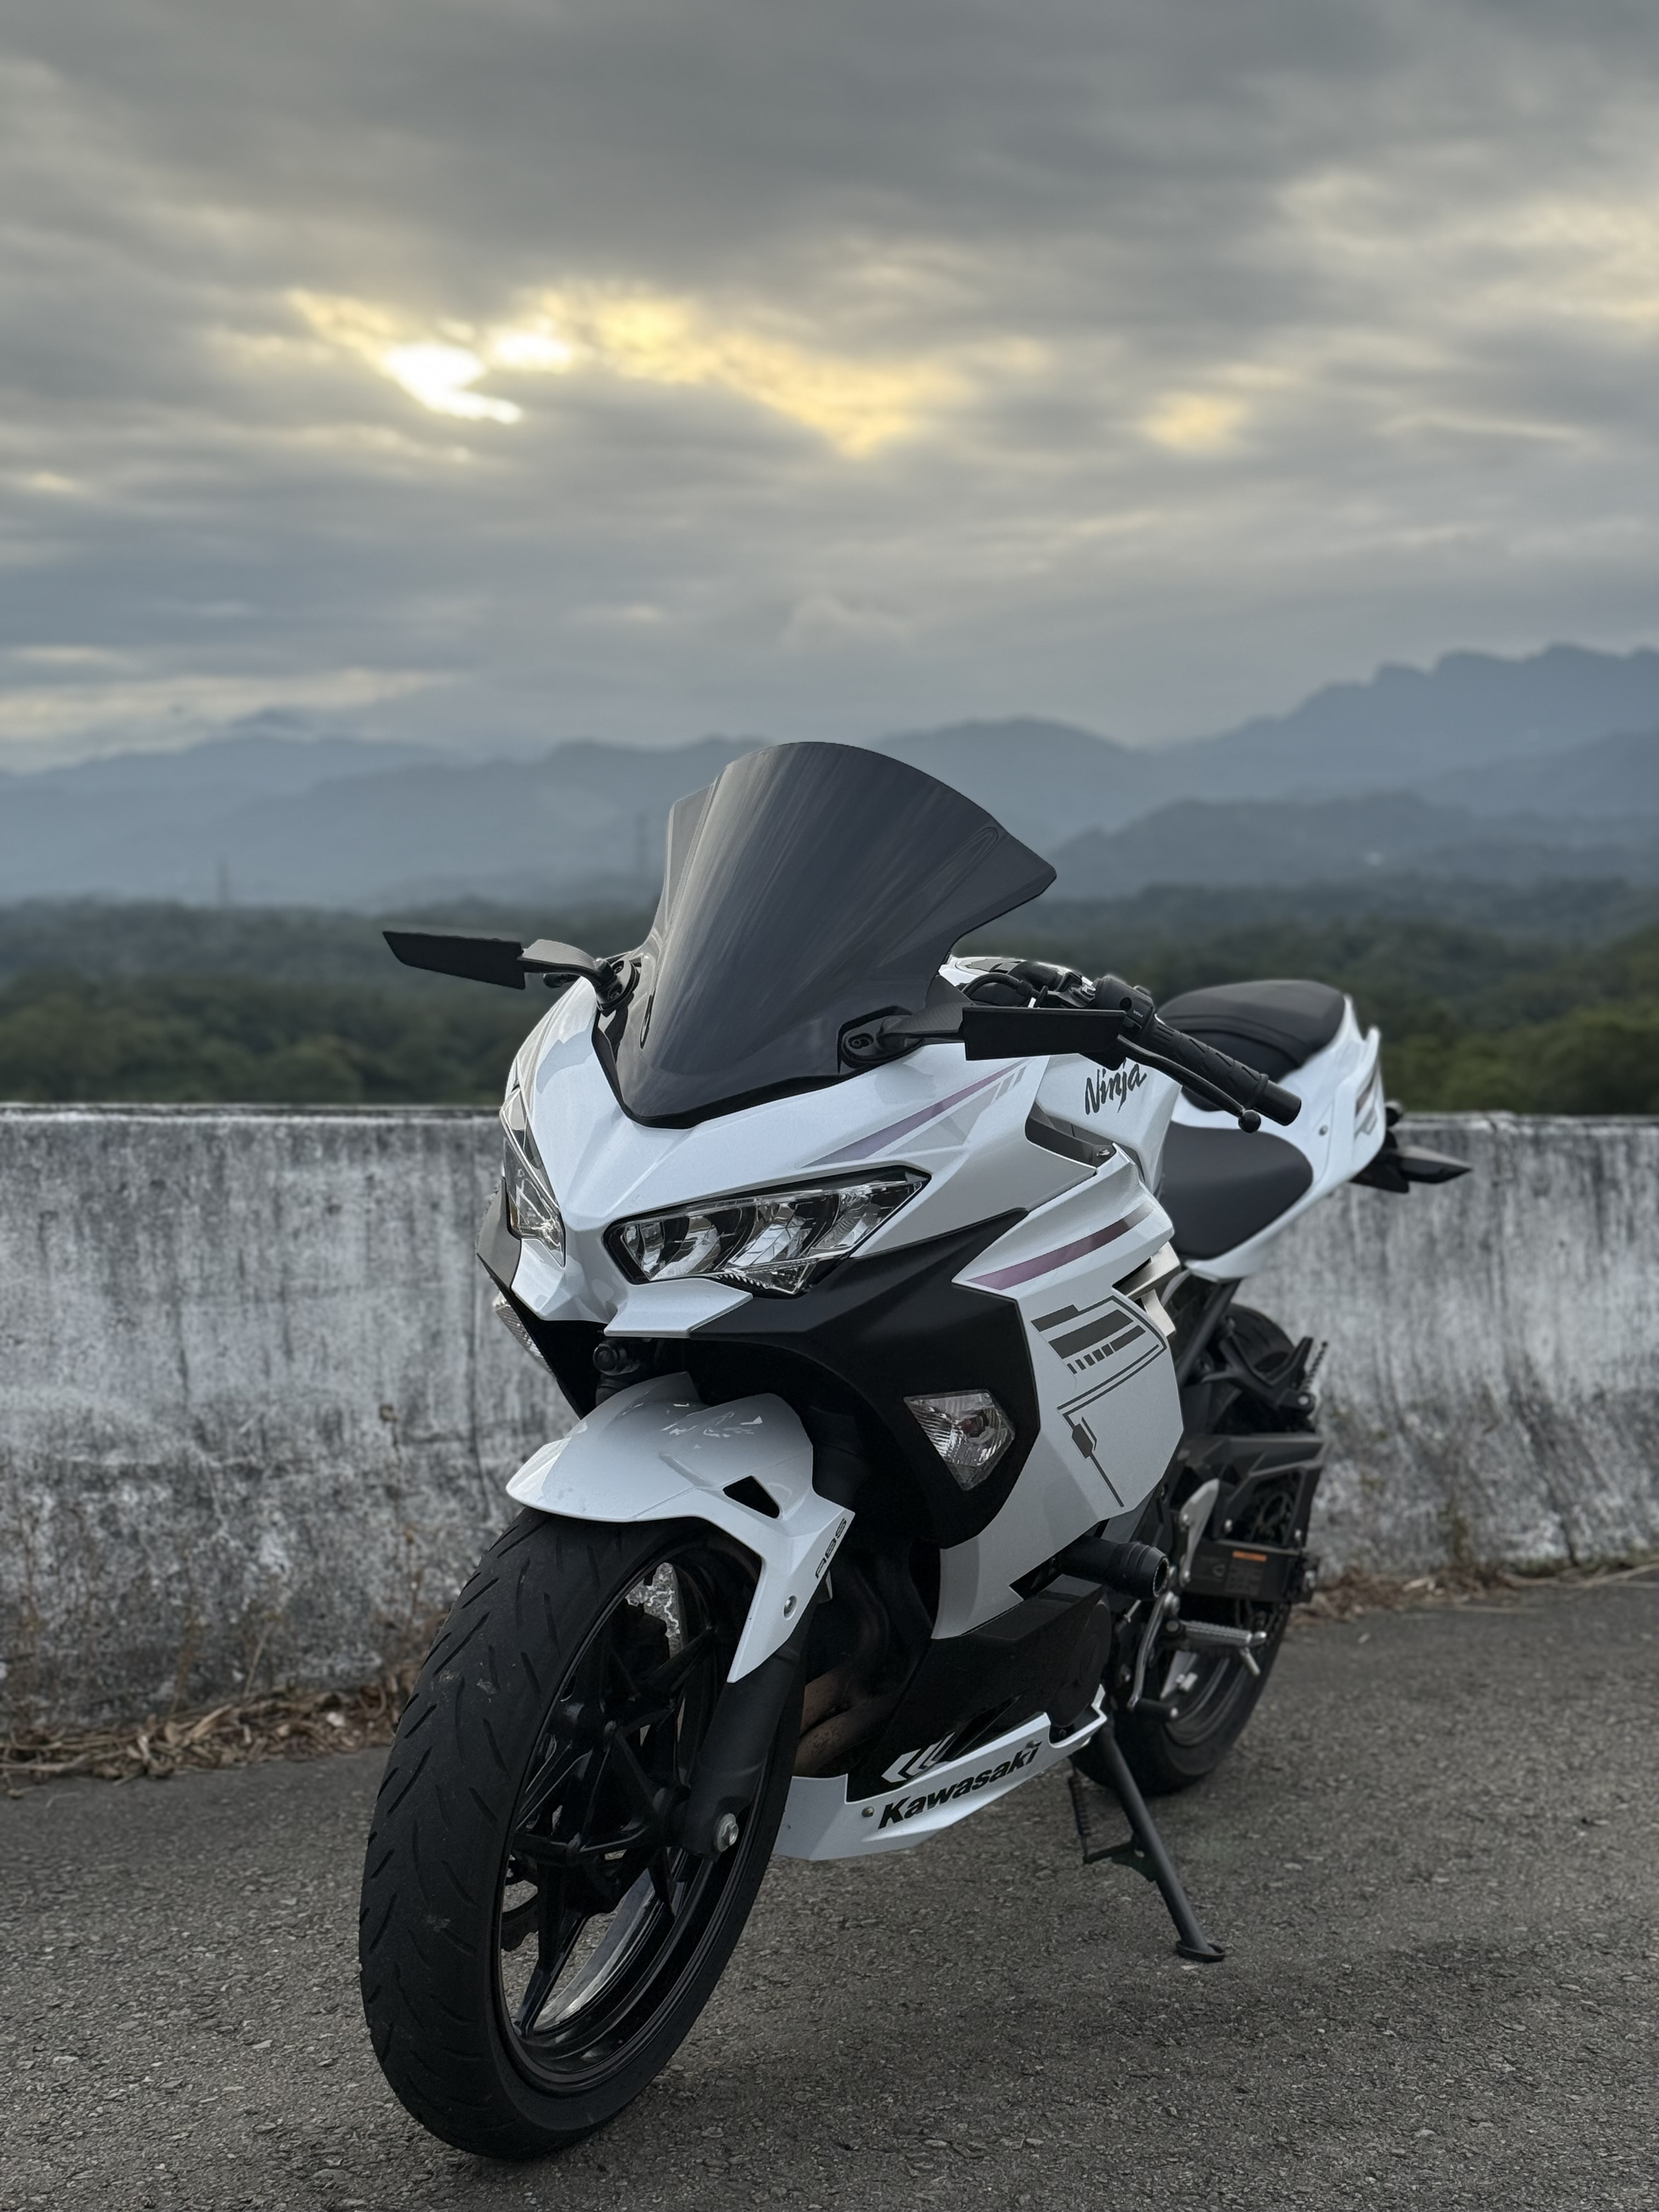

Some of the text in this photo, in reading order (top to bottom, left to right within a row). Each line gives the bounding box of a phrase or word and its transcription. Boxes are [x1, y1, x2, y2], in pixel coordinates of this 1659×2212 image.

[1085, 1058, 1147, 1115] Ninja
[815, 1517, 847, 1579] ABS
[878, 1740, 1042, 1830] Kawasaki
